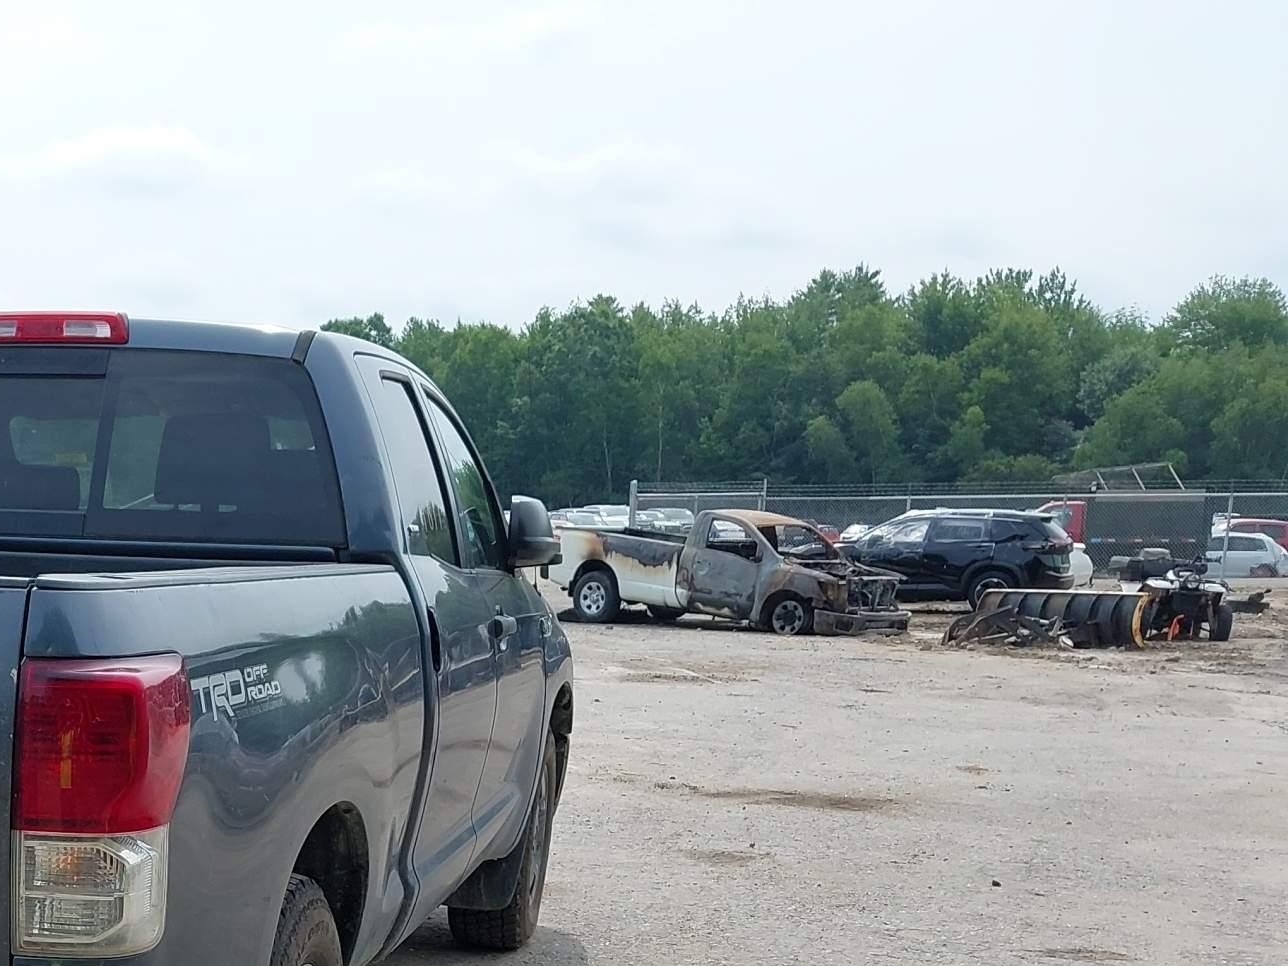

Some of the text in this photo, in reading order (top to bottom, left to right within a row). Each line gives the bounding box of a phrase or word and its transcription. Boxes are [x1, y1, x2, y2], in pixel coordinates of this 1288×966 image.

[244, 664, 269, 682] OFF
[190, 669, 247, 721] TRD
[247, 680, 281, 701] ROAD
